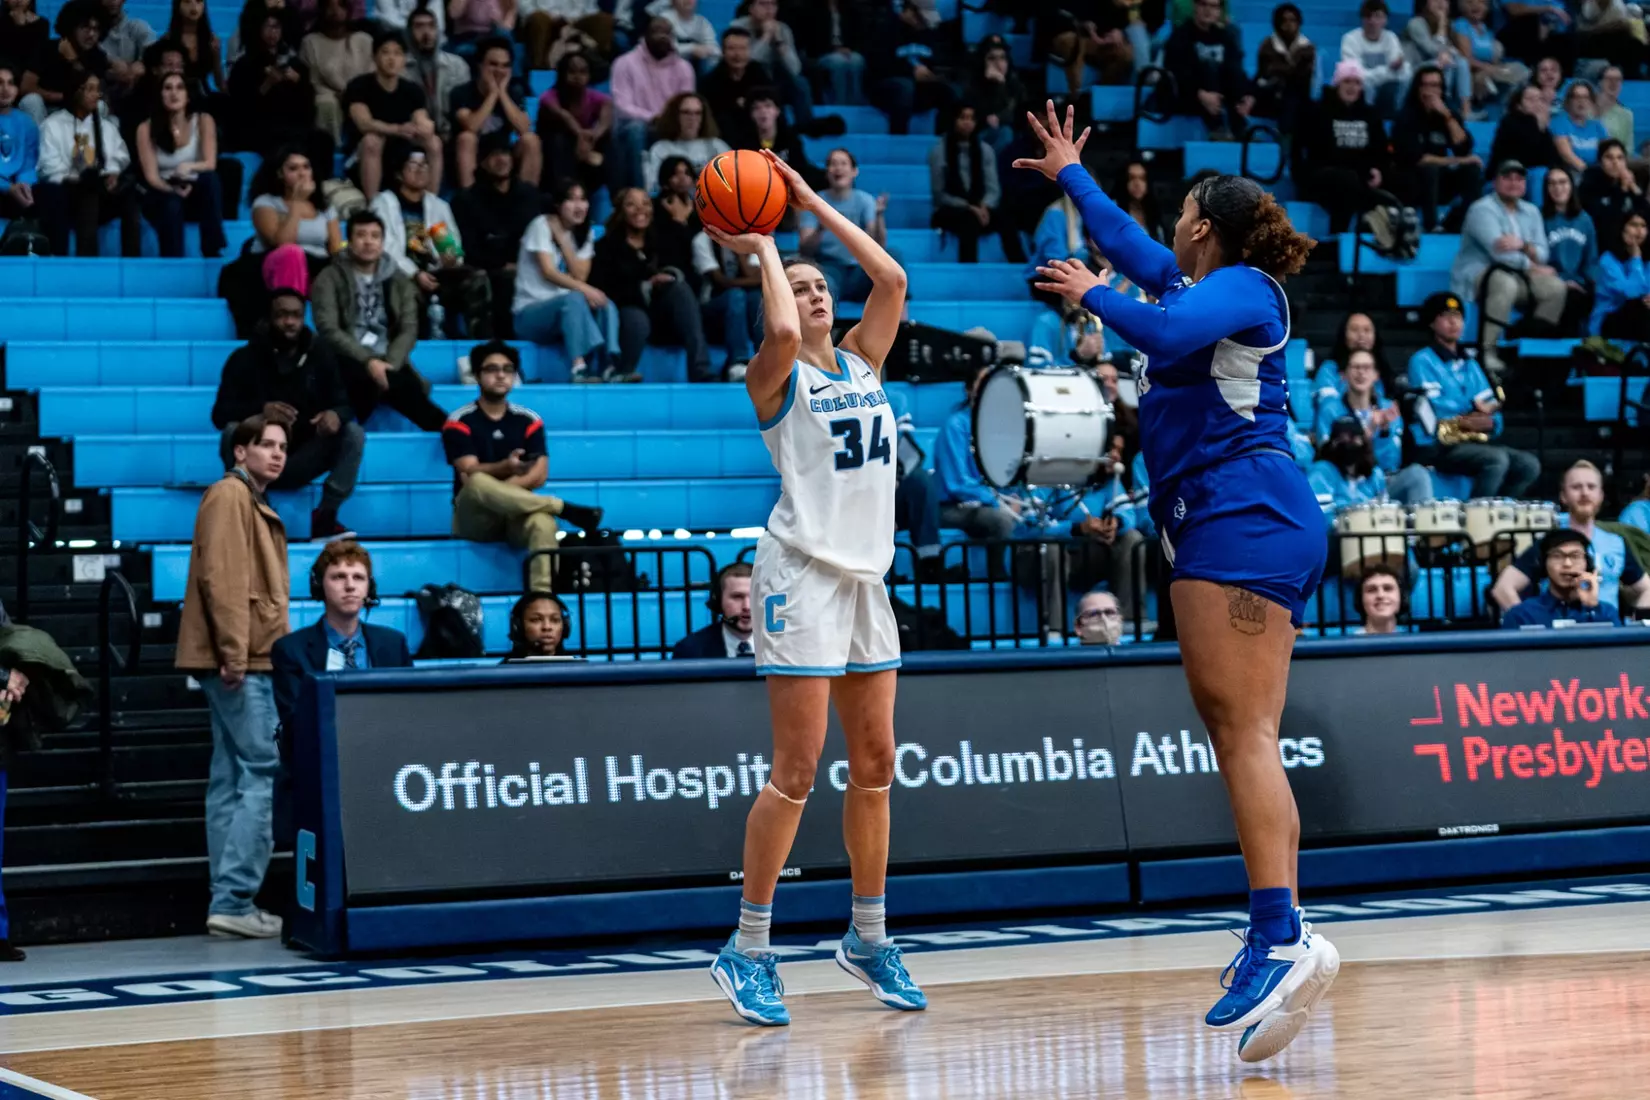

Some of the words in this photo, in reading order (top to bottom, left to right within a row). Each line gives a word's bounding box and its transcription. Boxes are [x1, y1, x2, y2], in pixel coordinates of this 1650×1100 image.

[810, 389, 888, 412] COLUBI
[829, 414, 891, 471] 34
[764, 593, 787, 633] C
[393, 757, 590, 811] Official
[604, 753, 814, 810] Hospit
[895, 736, 1116, 788] Columbia
[1130, 730, 1325, 777] Athcs
[297, 828, 316, 912] C
[729, 867, 802, 880] DAICS
